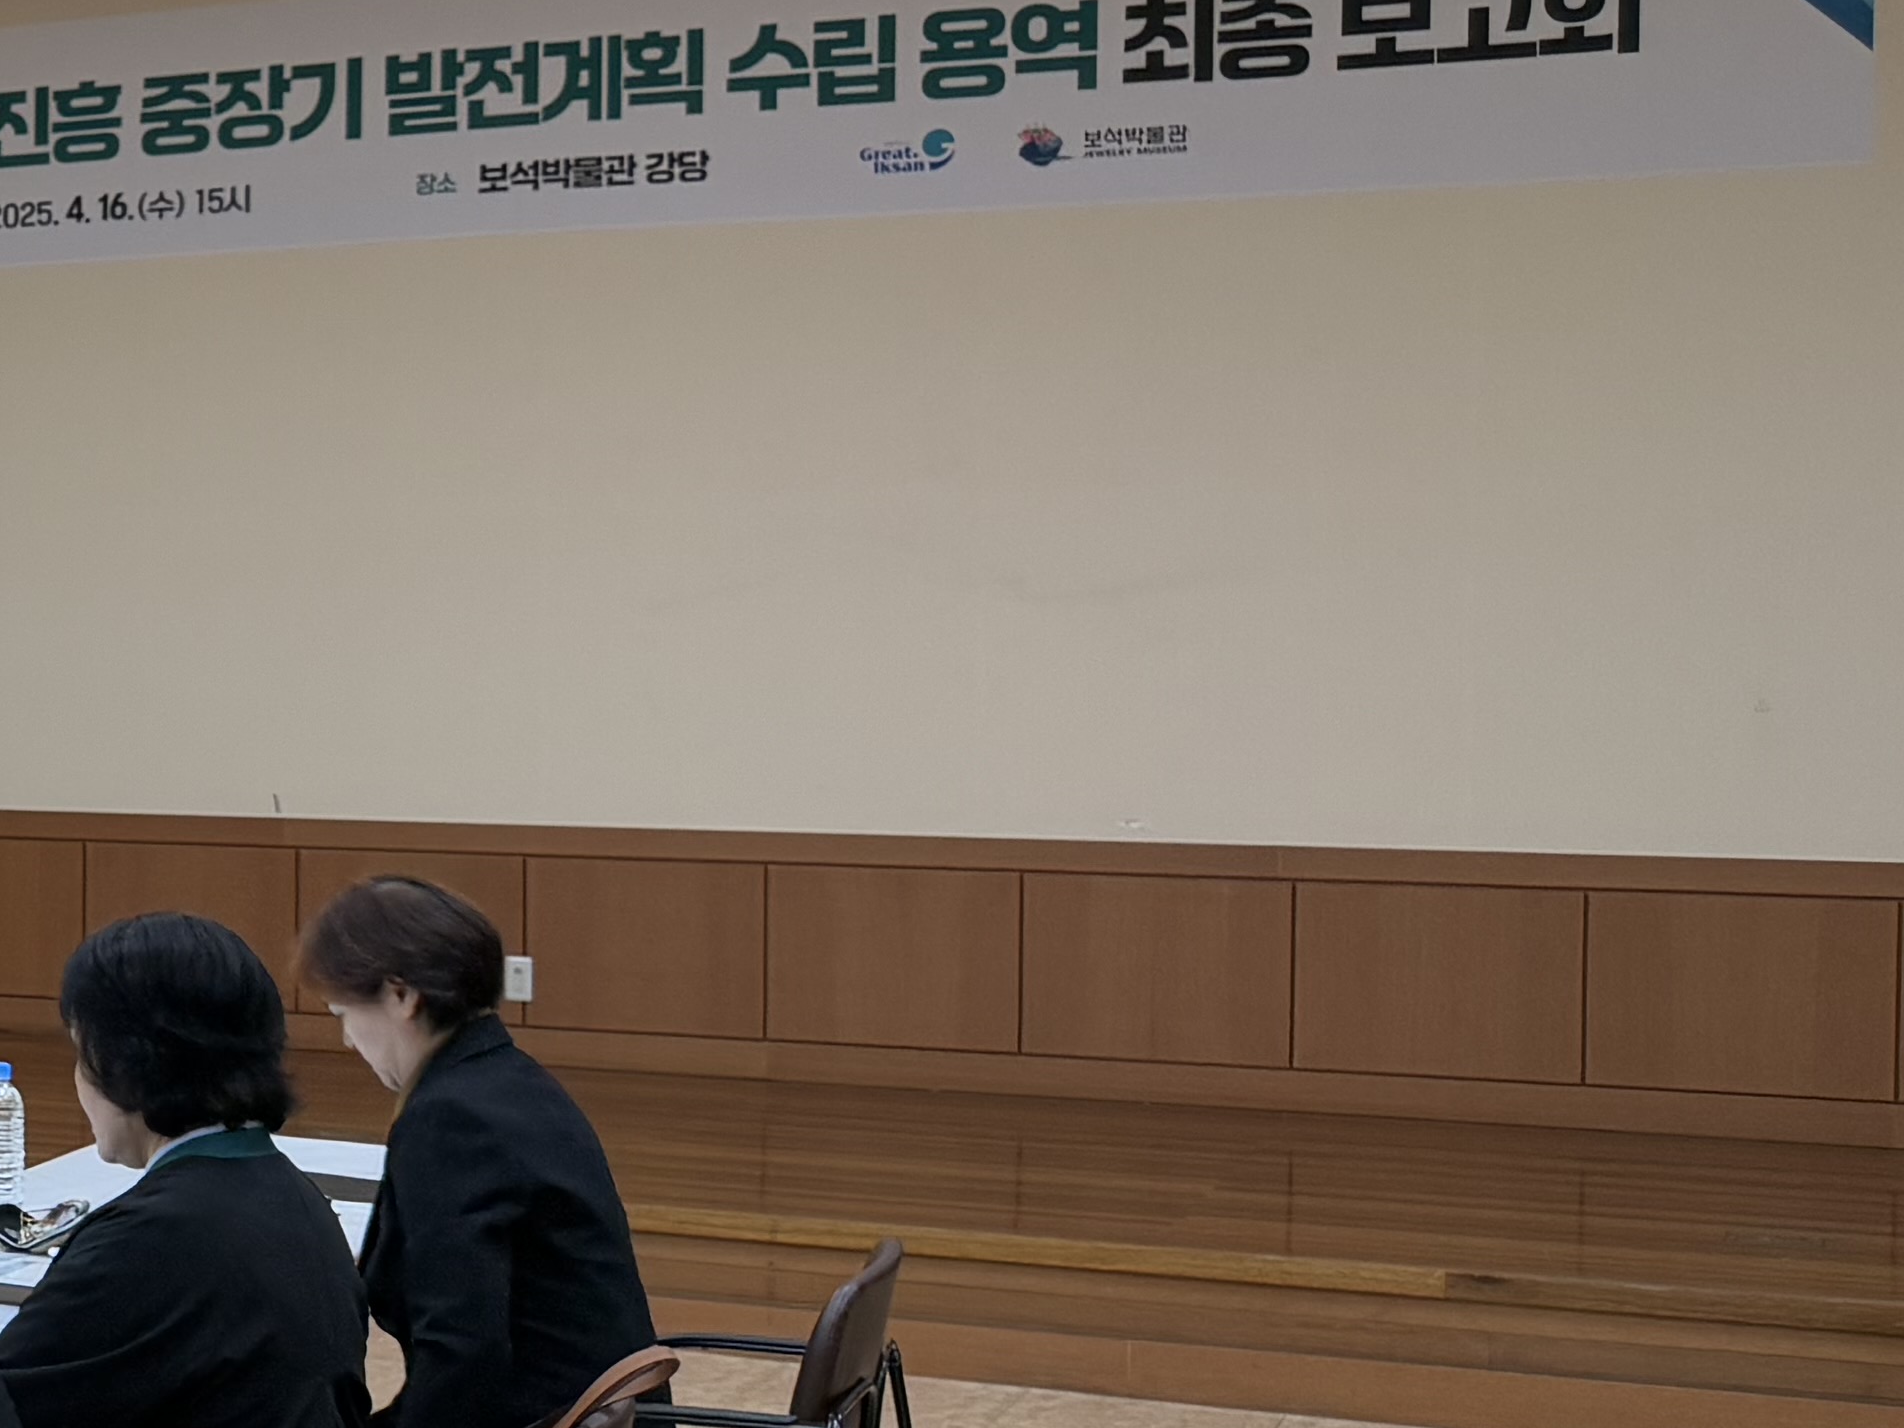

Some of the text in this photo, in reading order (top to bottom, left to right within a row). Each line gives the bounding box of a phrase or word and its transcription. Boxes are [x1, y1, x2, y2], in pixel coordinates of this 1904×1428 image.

[139, 56, 363, 154] 중장기
[383, 27, 704, 137] 발전계획
[726, 13, 897, 112] 수립
[1083, 124, 1188, 149] 보석박물관
[416, 149, 710, 196] 장소 보석박물관 강당
[65, 195, 91, 224] 4.
[195, 184, 251, 215] 15시
